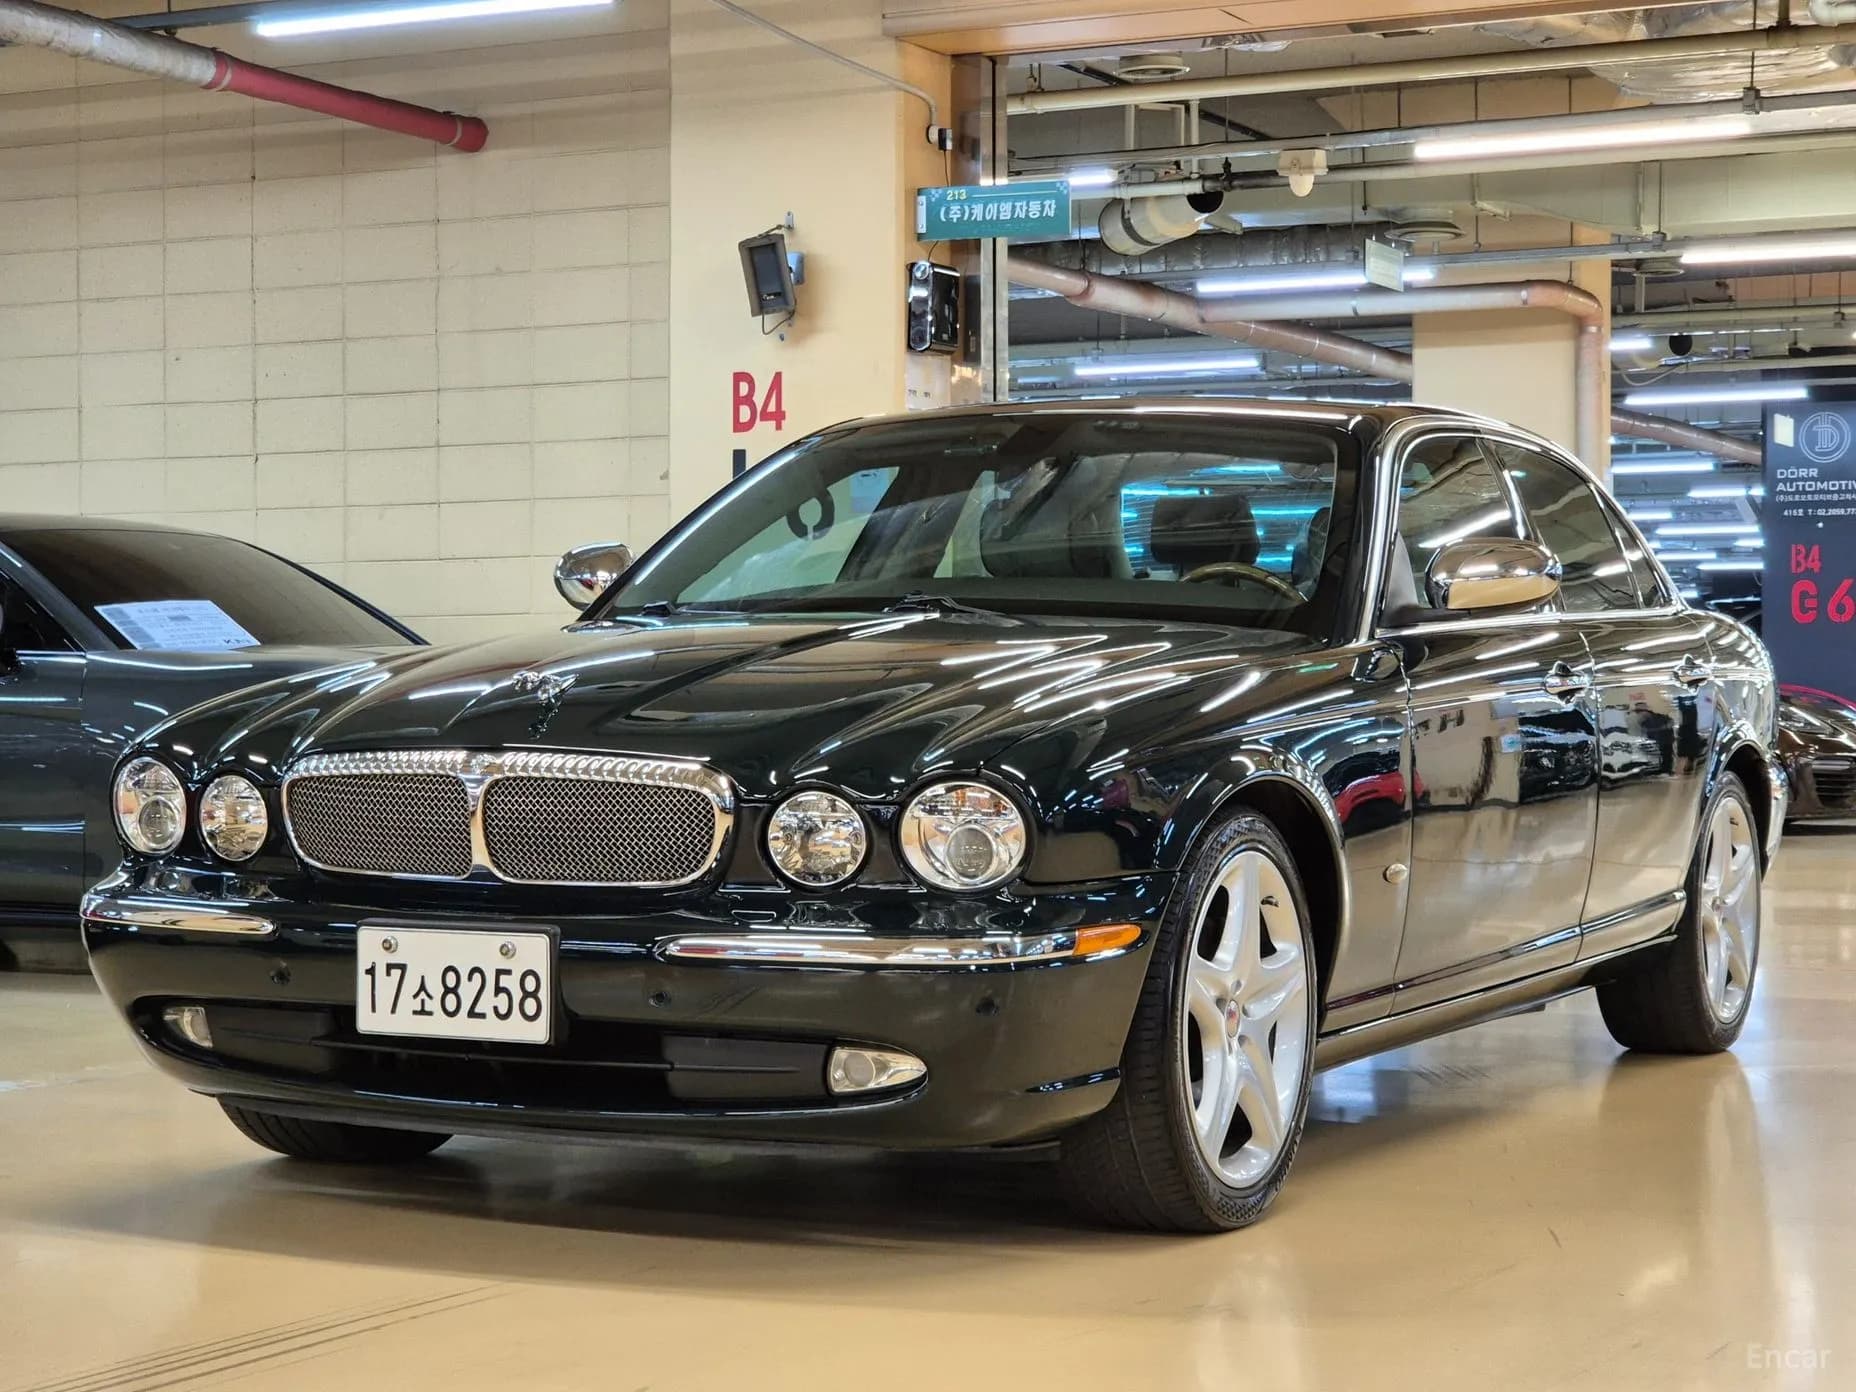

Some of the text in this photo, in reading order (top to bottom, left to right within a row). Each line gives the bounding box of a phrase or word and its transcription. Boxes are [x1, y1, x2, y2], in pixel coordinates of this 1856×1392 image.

[946, 189, 967, 201] 213
[732, 371, 786, 433] B4
[1791, 544, 1821, 573] B4
[364, 961, 543, 1023] 17소8258
